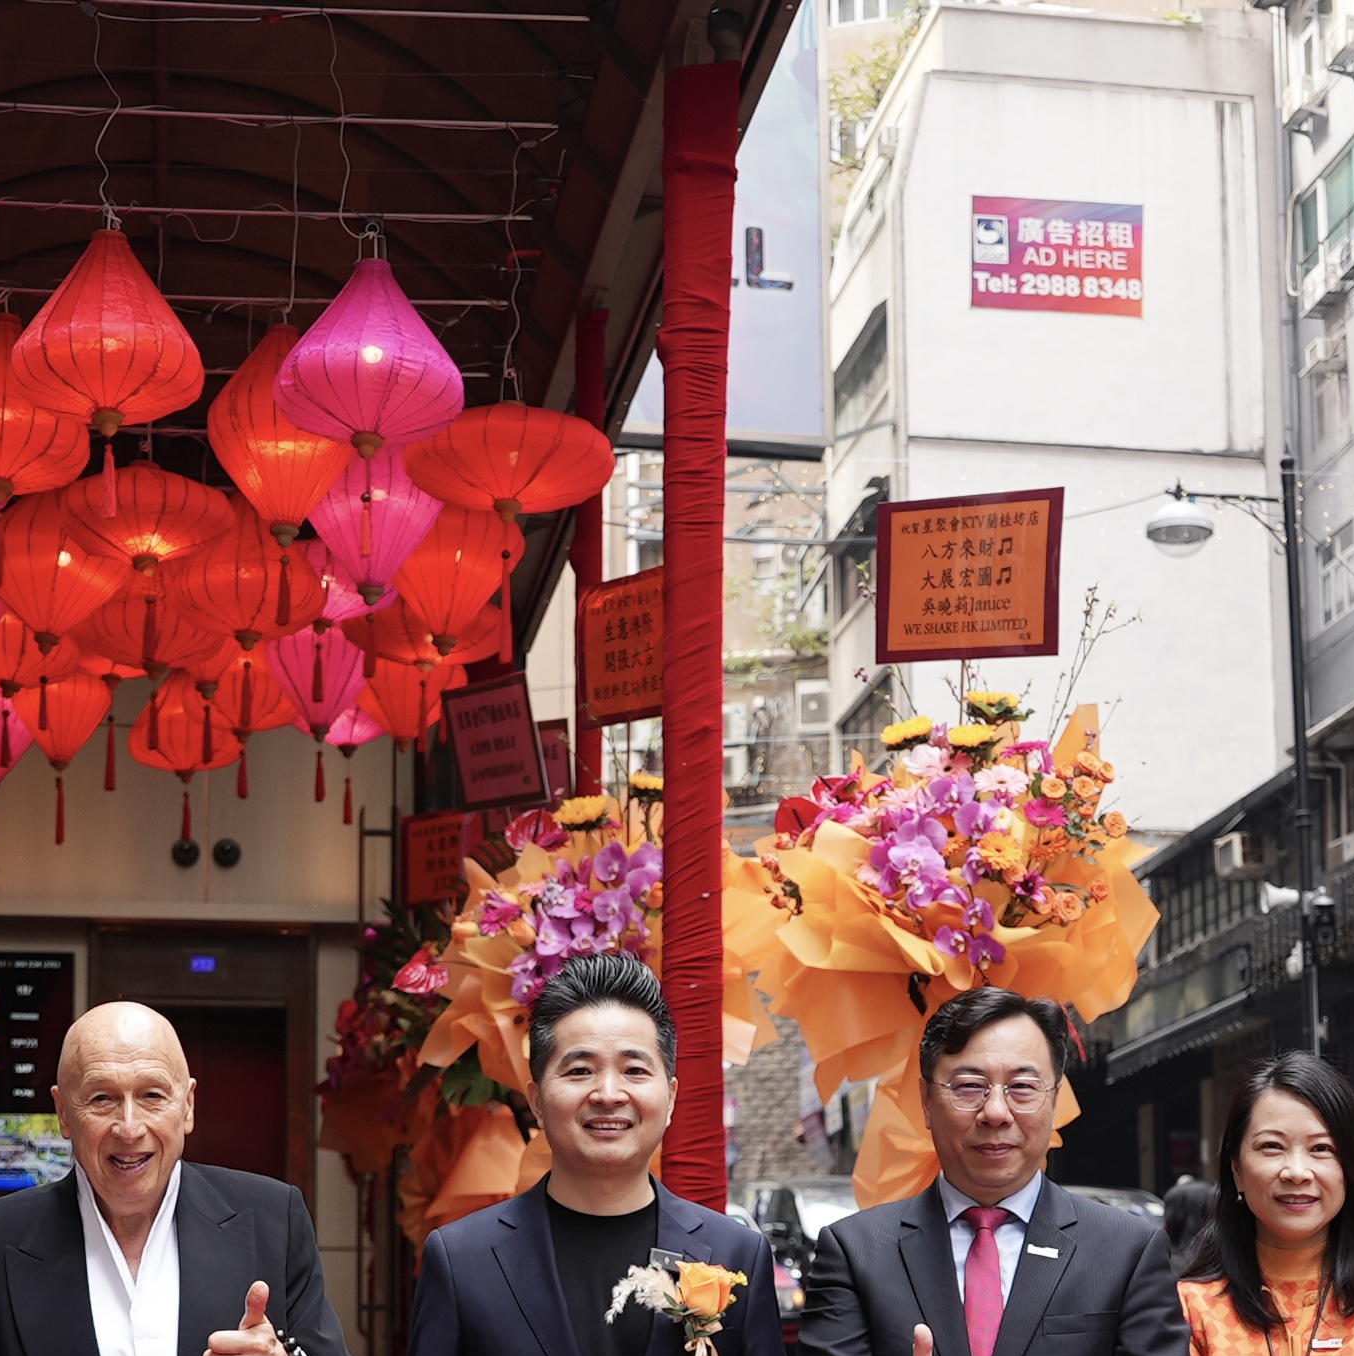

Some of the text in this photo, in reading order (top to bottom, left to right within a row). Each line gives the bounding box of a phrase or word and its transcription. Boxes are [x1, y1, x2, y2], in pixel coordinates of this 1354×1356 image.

[1017, 216, 1135, 249] 廣告招租
[1022, 246, 1057, 267] AD
[1062, 248, 1129, 271] HERE
[973, 271, 1142, 301] Tel: 2988 8348
[920, 565, 992, 590] 大展宏圖
[903, 617, 1028, 636] WE SHARE HK LIMITED
